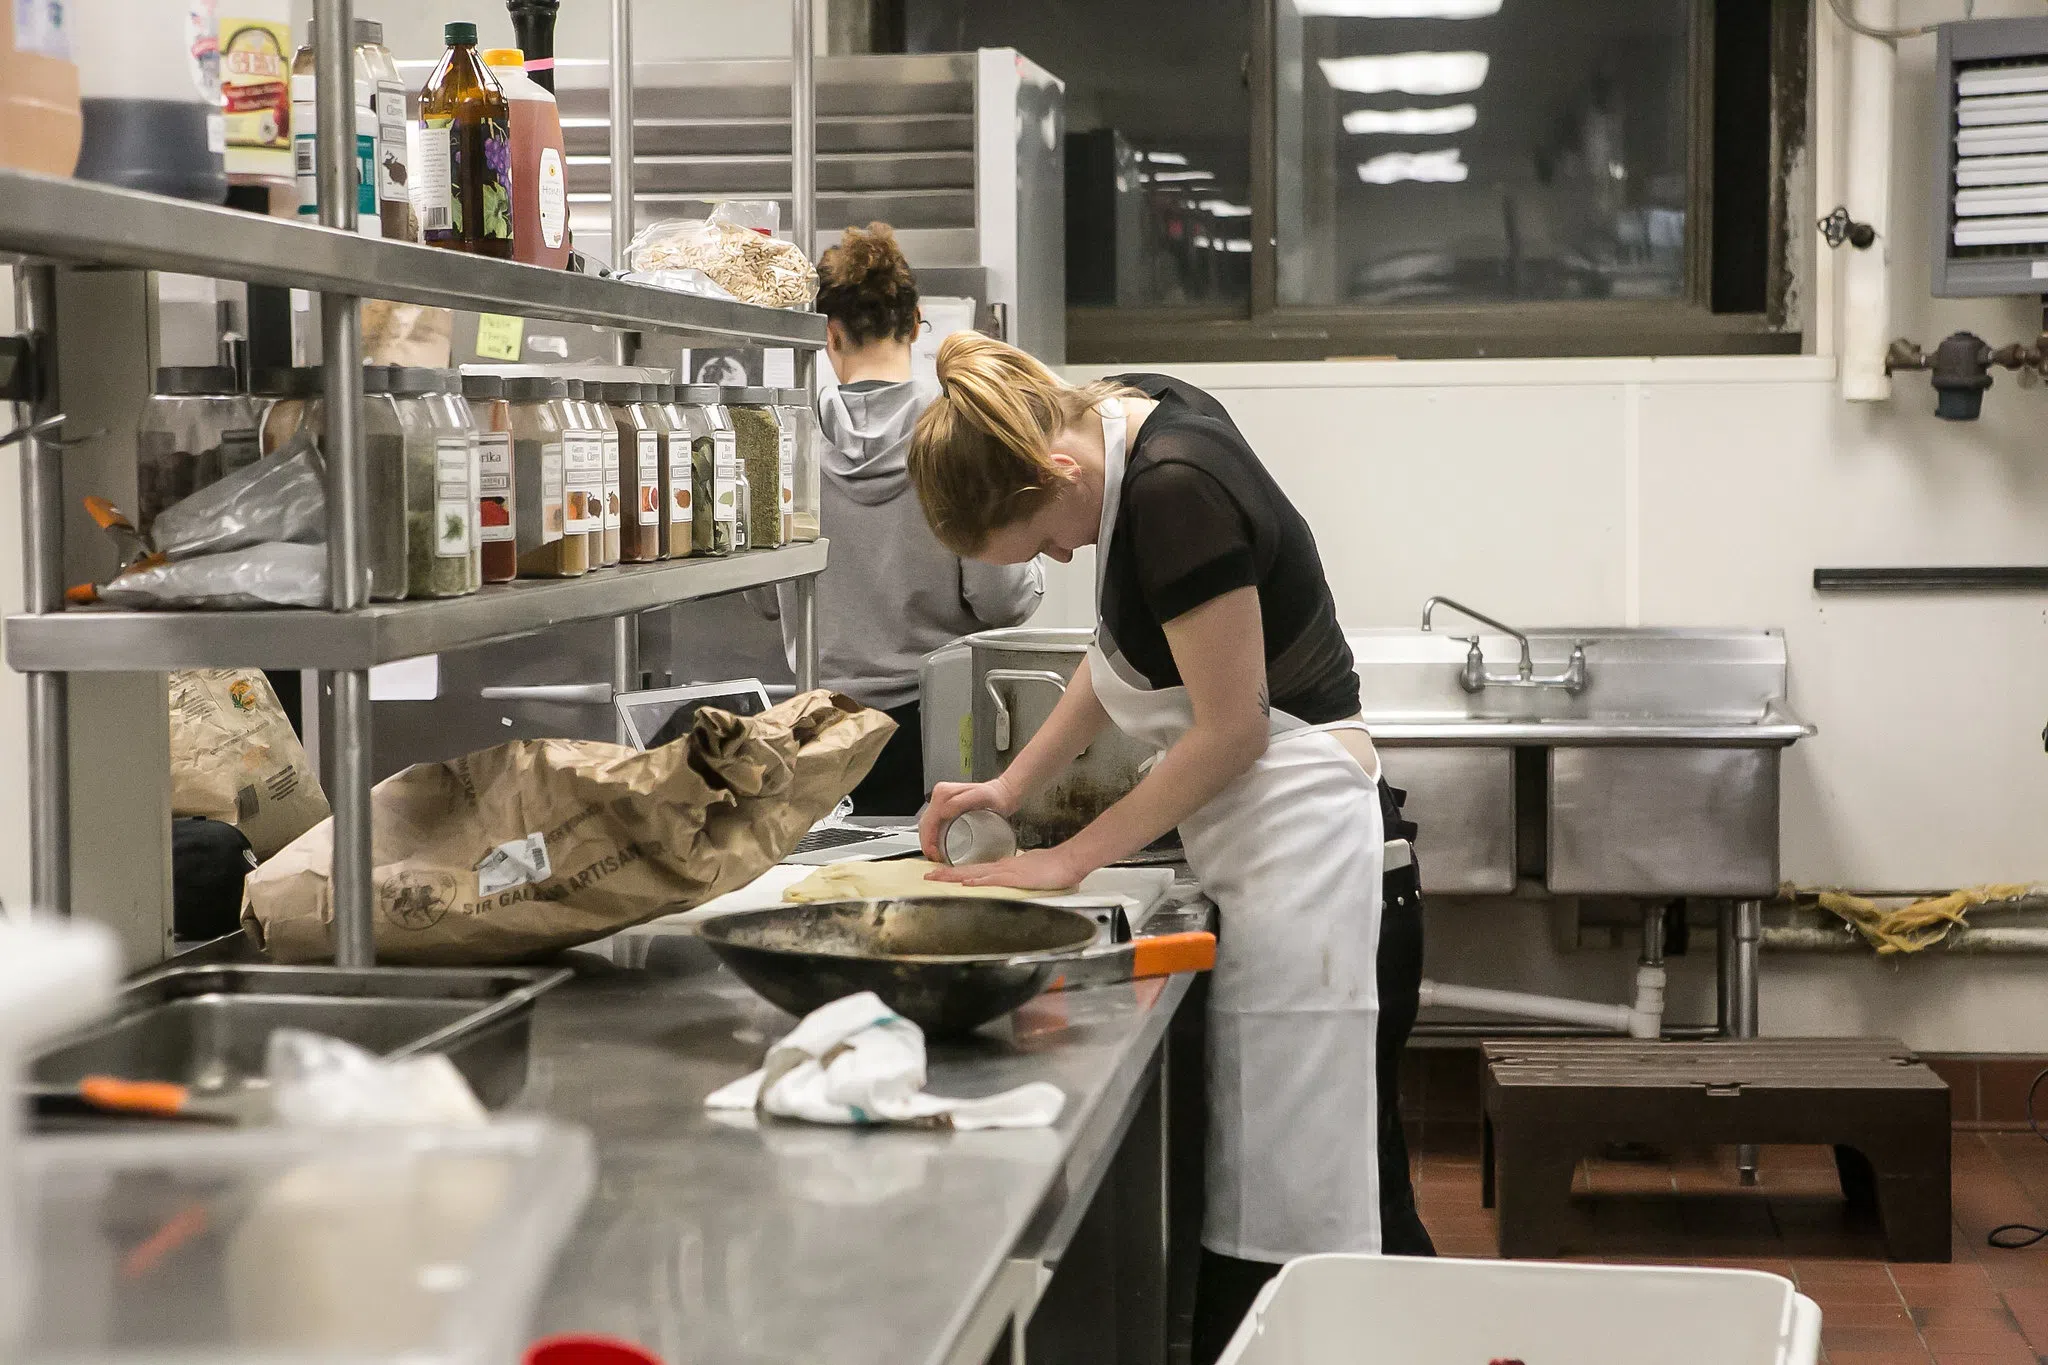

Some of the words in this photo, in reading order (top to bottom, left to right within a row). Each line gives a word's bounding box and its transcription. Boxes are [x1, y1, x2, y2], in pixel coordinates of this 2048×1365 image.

[227, 51, 283, 77] GEM
[542, 184, 563, 197] Honey
[480, 451, 502, 463] rika
[463, 897, 492, 916] SIR
